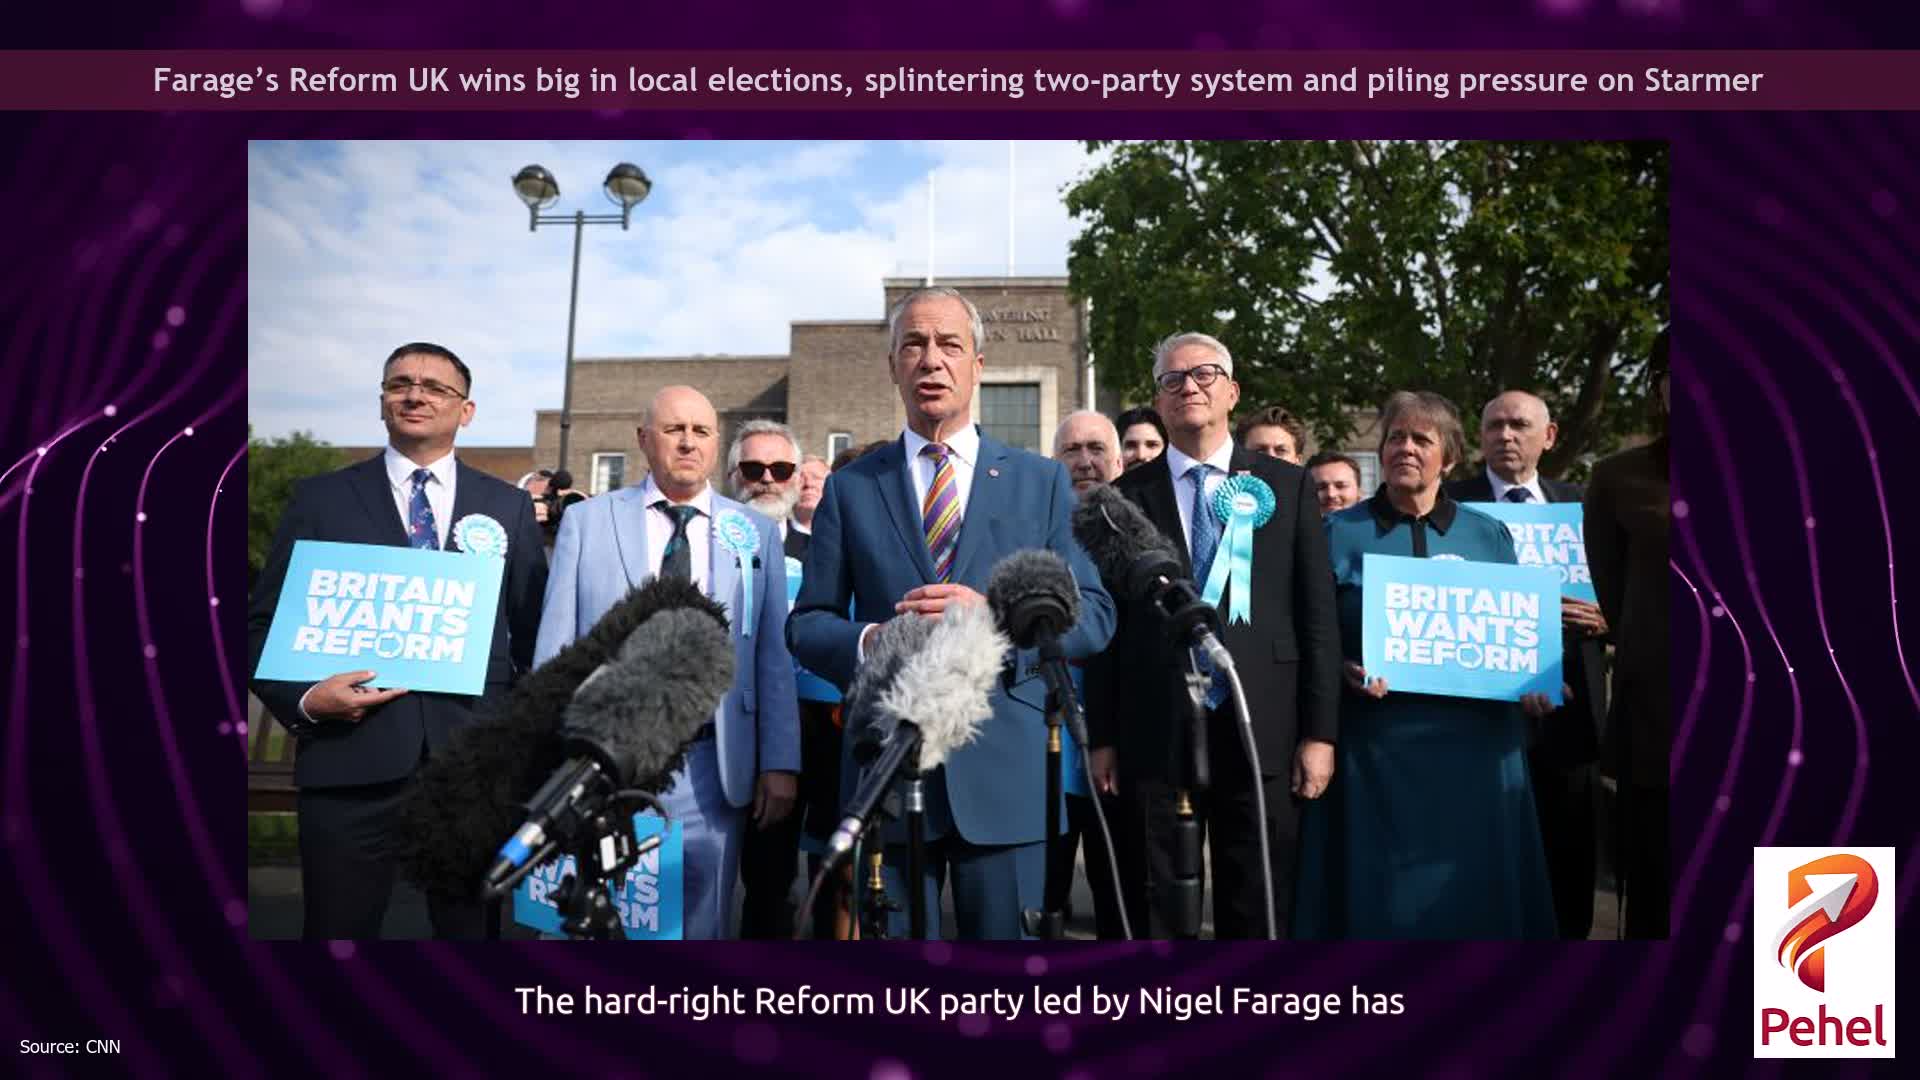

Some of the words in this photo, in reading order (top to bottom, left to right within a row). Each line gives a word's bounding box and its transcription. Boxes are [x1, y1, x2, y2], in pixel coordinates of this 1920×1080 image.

[1507, 522, 1585, 544] RITAI
[1514, 543, 1588, 565] ANT
[308, 569, 476, 607] BRITAIN
[1385, 582, 1540, 619] BRITAIN
[306, 597, 470, 636] WANTS
[1385, 609, 1540, 648] WANTS
[293, 626, 465, 663] REFORM
[1384, 637, 1538, 674] REFORM
